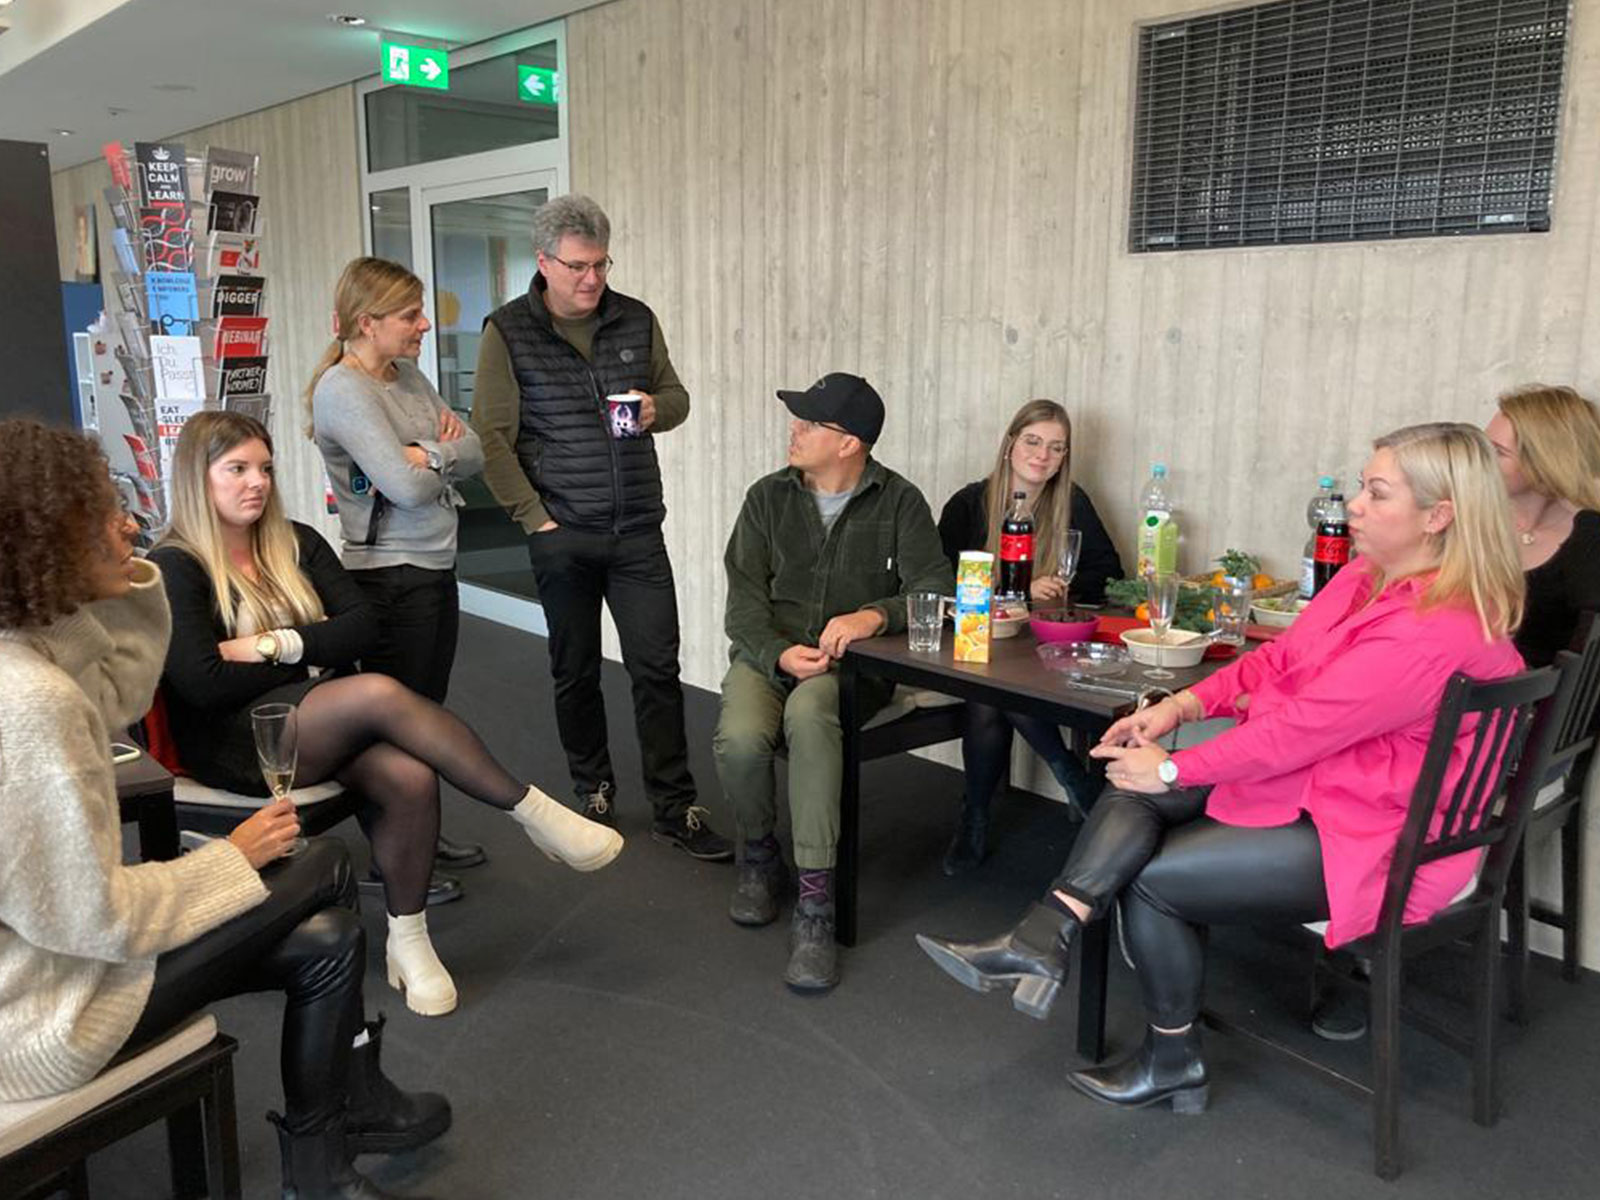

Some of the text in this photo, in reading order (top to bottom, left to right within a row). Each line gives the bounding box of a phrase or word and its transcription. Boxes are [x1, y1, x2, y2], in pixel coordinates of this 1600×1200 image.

[148, 162, 178, 172] KEEP
[148, 173, 179, 183] CALM
[211, 165, 246, 184] grow
[147, 191, 185, 200] LEARN
[217, 291, 259, 304] DIGGER
[160, 406, 180, 414] EAT
[161, 415, 186, 423] SLEE
[163, 426, 183, 436] LEA
